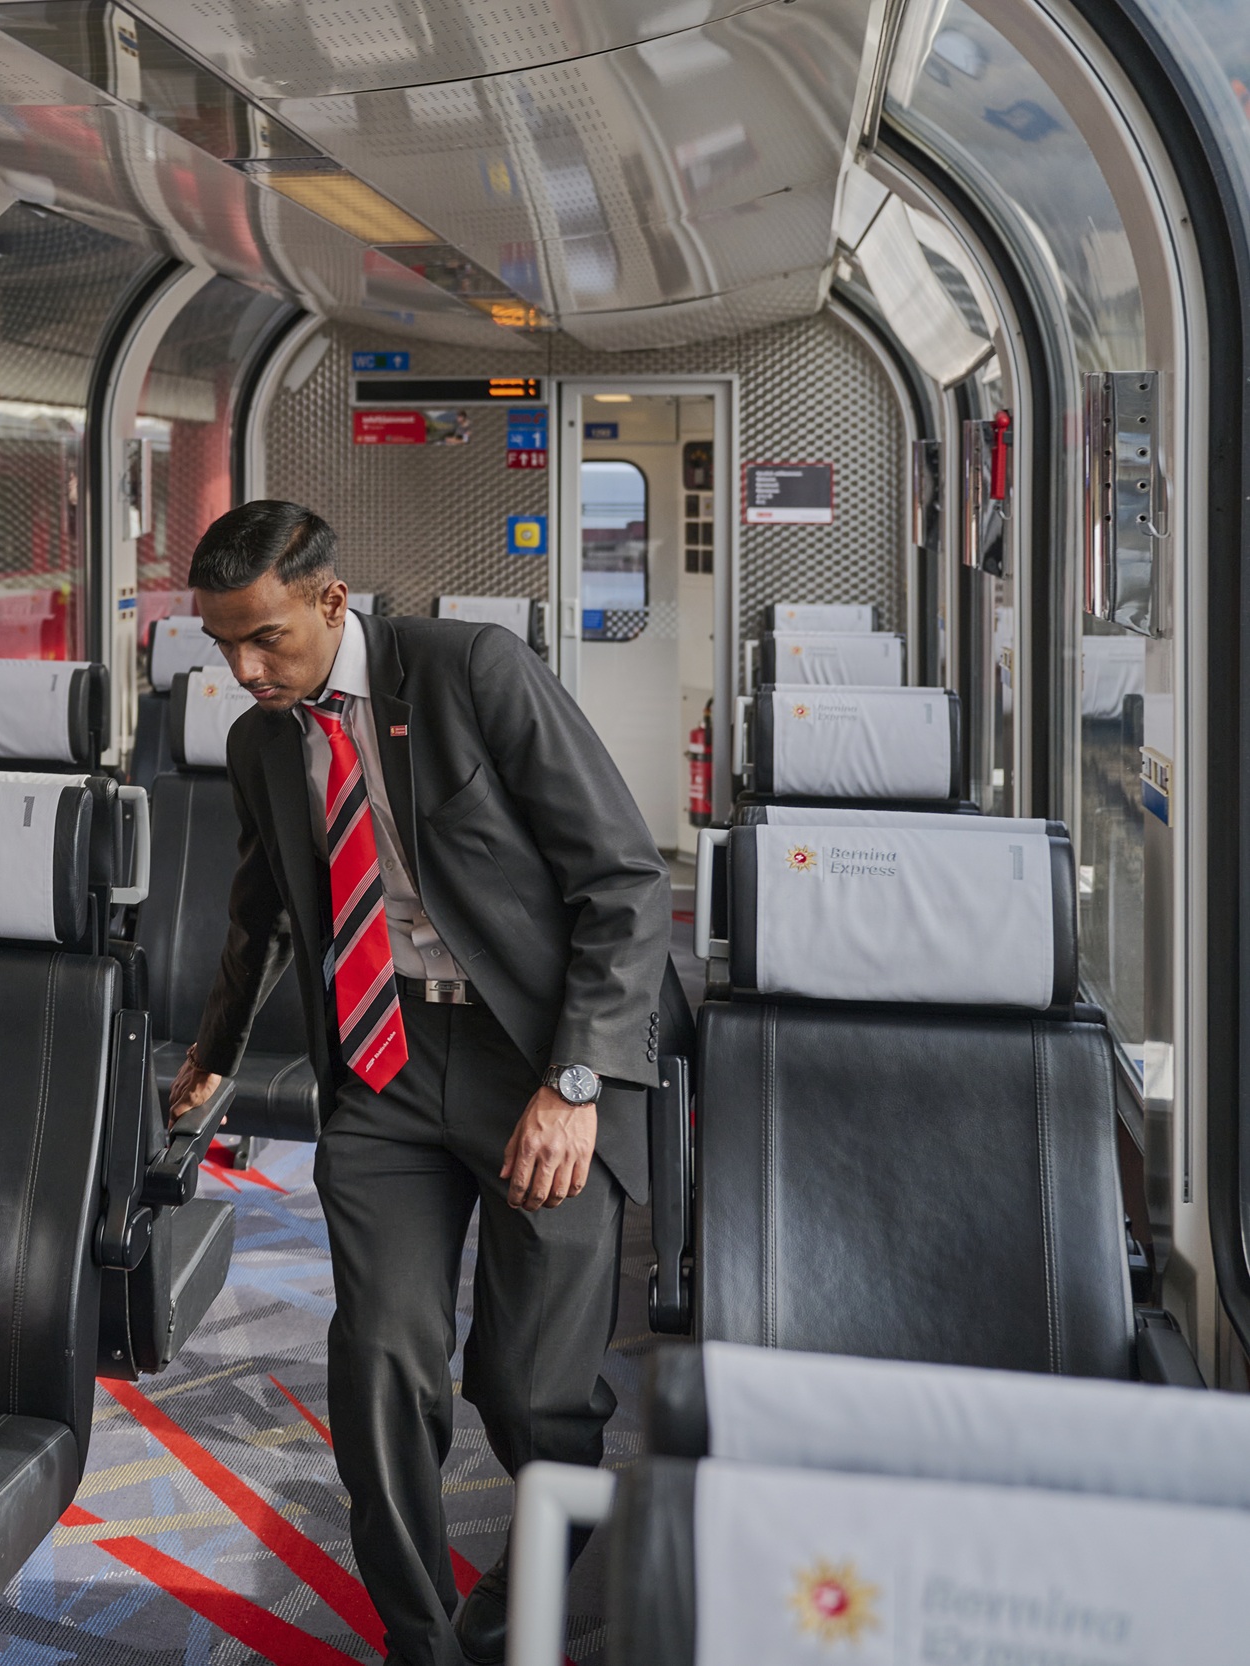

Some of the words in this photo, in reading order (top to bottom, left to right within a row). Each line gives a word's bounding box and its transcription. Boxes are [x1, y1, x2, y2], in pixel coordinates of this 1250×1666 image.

[354, 355, 375, 368] WC
[532, 432, 541, 447] 1
[50, 674, 59, 692] 1
[923, 703, 933, 724] 1
[22, 796, 36, 827] 1
[829, 846, 898, 862] Bernina
[1008, 844, 1024, 881] 1
[829, 861, 897, 877] Express
[920, 1572, 1134, 1646] Bernina
